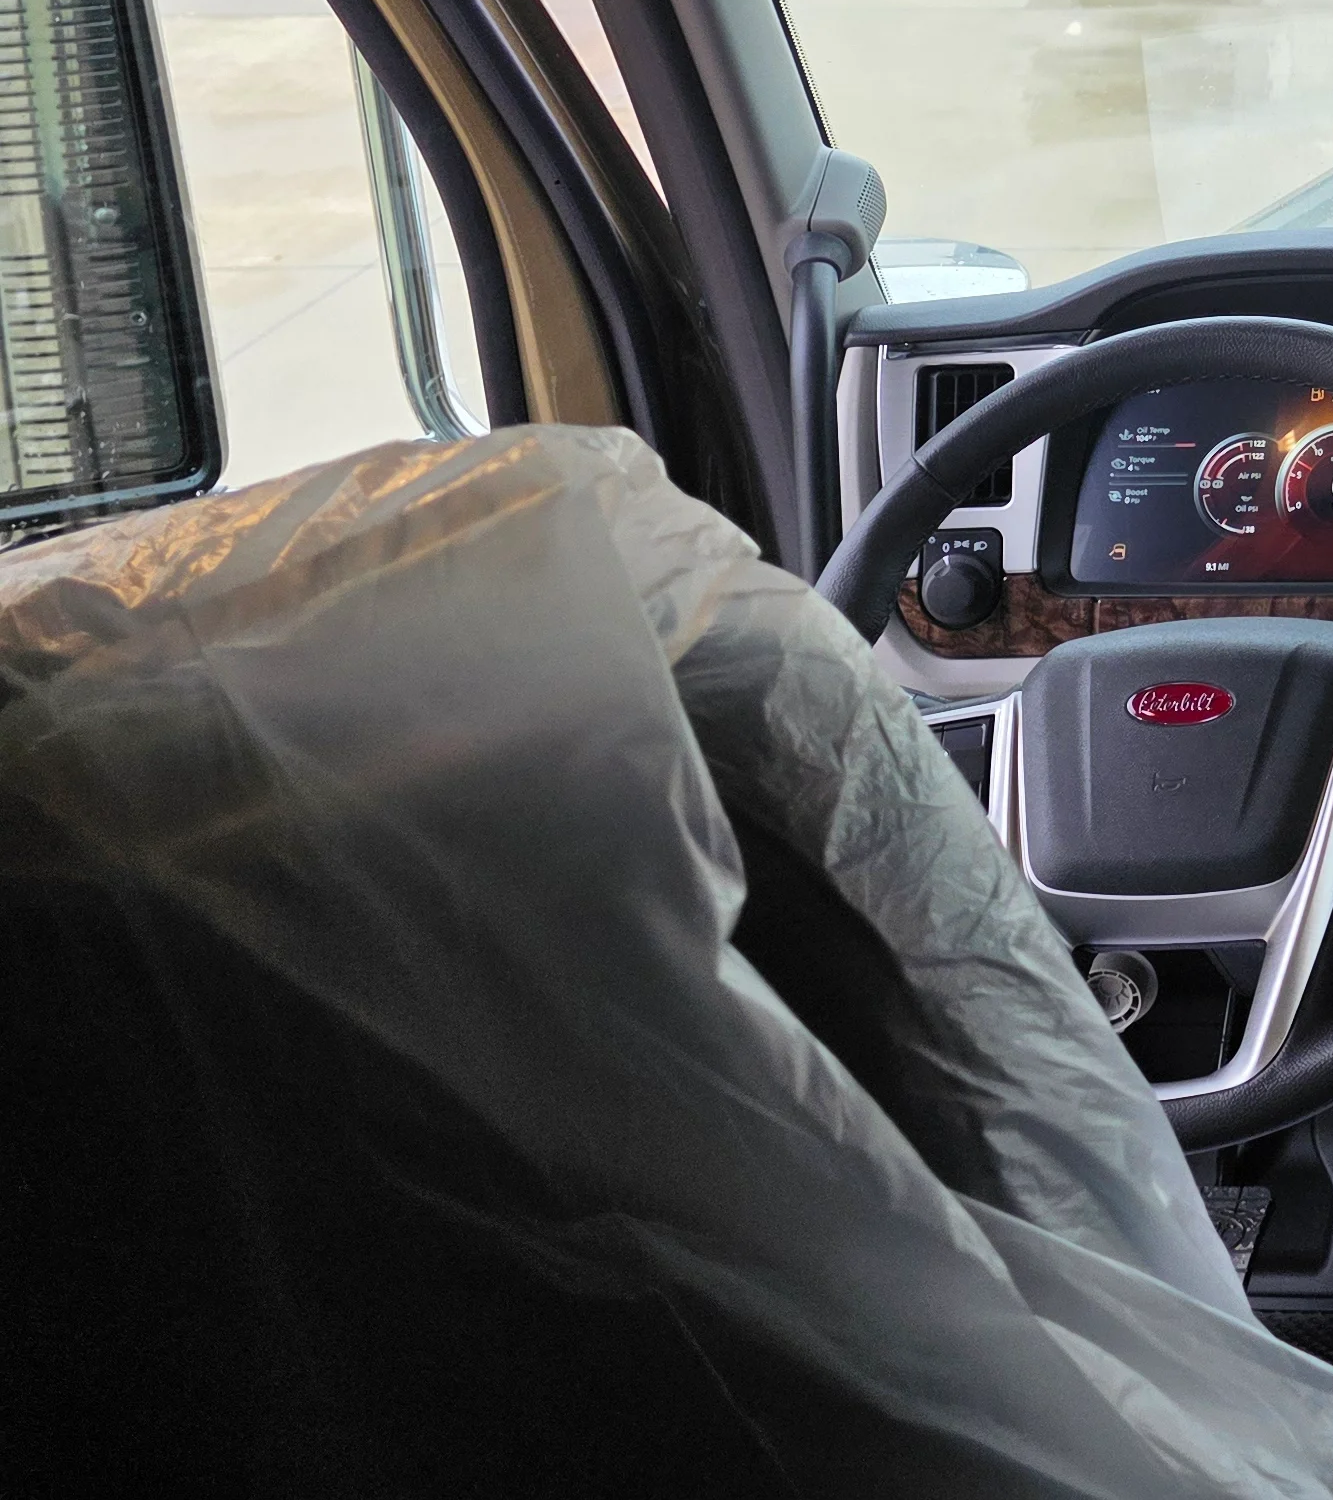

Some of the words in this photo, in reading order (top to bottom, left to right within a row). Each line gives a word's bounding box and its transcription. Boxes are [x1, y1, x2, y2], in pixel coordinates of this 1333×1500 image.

[1136, 426, 1148, 434] Oil
[1149, 427, 1170, 436] Temp
[1253, 440, 1266, 448] 122
[1252, 452, 1265, 460] 122
[1314, 448, 1323, 457] 10
[1129, 456, 1156, 464] Torque
[1238, 472, 1250, 480] Air
[1296, 471, 1302, 479] 5
[1125, 488, 1148, 497] Boost
[1235, 505, 1247, 513] Oil
[1205, 563, 1217, 572] 9.1
[1217, 563, 1229, 571] MI
[1137, 689, 1216, 714] Peterbilt
